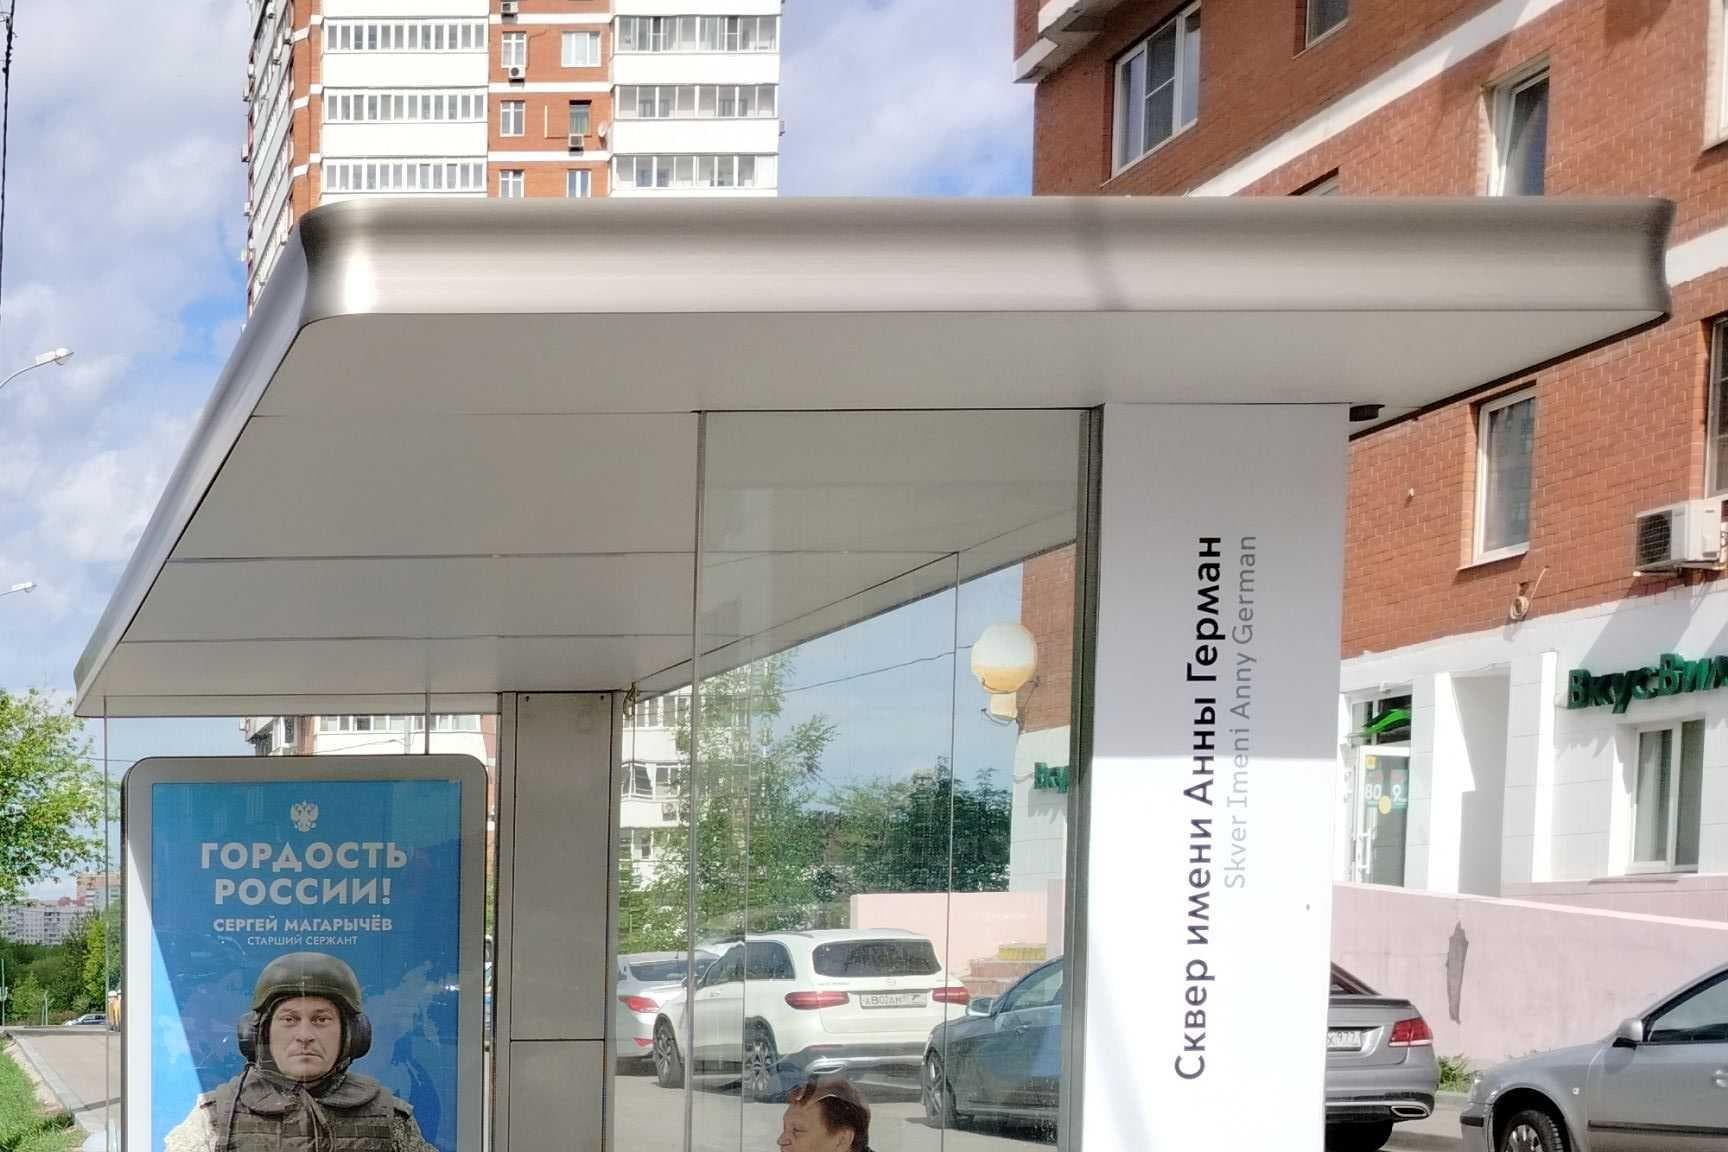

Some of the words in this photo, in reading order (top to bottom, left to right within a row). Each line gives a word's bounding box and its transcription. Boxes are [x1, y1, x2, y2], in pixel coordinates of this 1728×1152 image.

[1186, 537, 1226, 682] Герман
[1232, 536, 1257, 645] German
[1229, 652, 1257, 720] Anny
[1183, 698, 1217, 806] Анны
[1226, 728, 1250, 808] Imeni
[200, 841, 408, 873] ГОРДОСТЬ
[1186, 818, 1213, 945] имени
[1223, 814, 1248, 889] Skver
[213, 915, 278, 932] СЕРГЕЙ
[284, 914, 393, 932] МАГАРЫЧЁВ
[215, 878, 392, 905] РОССИИ!
[247, 934, 302, 945] СТАРШИЙ
[305, 935, 358, 945] СЕРЖАНТ
[1174, 959, 1216, 1080] Сквер
